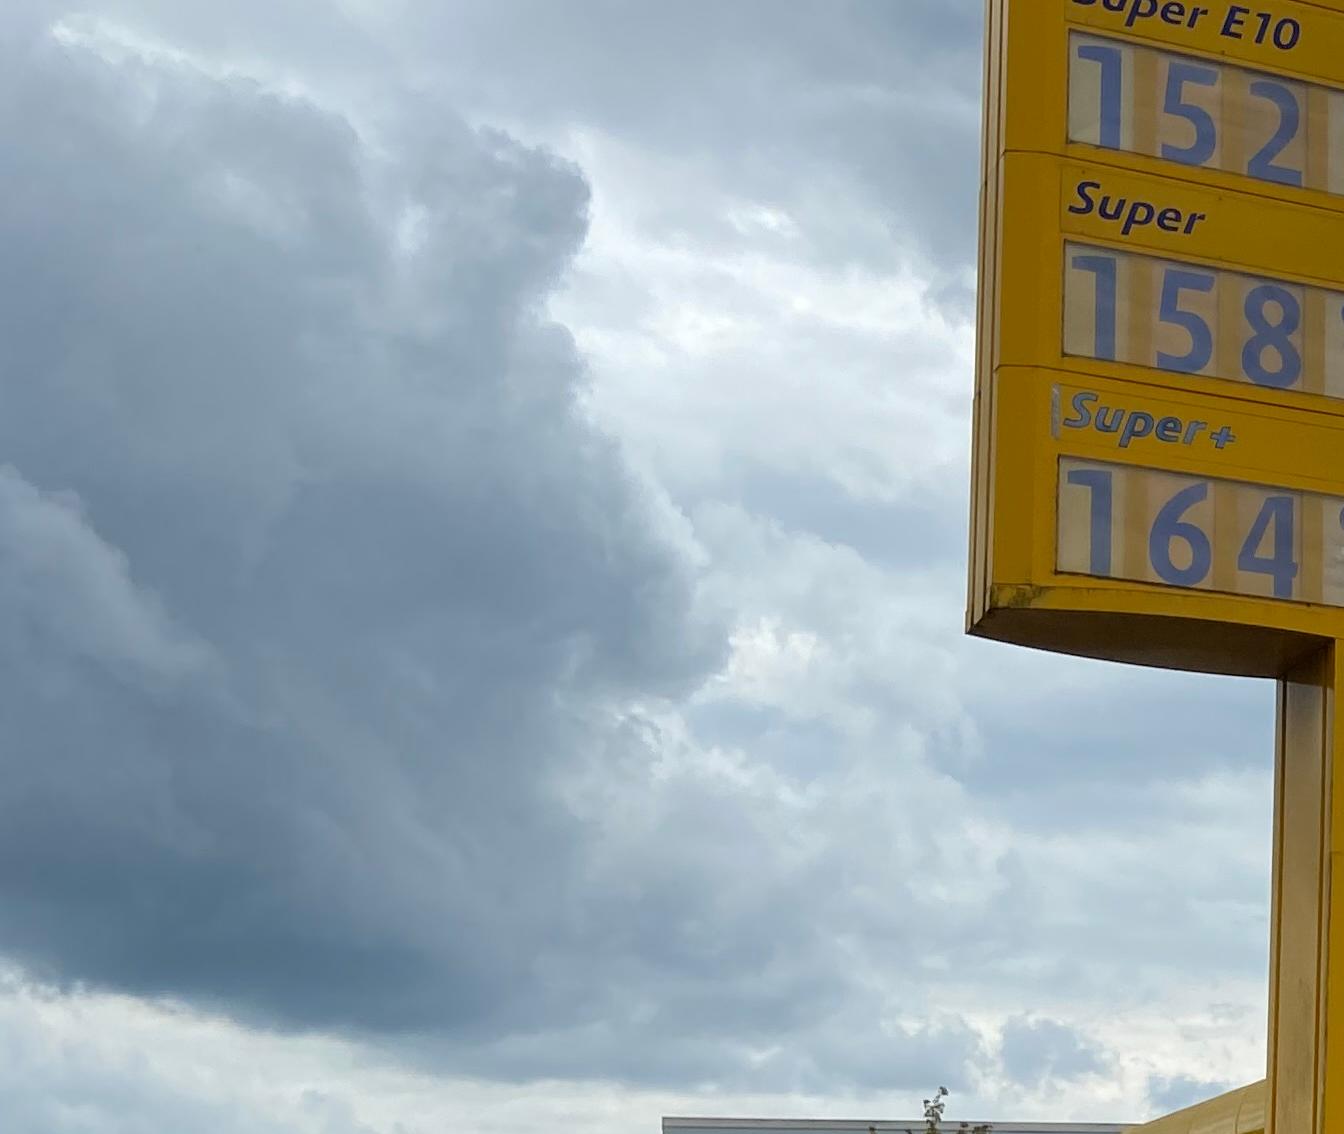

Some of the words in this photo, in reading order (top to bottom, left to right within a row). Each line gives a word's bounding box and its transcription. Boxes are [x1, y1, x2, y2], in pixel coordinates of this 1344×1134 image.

[1071, 0, 1208, 28] per
[1220, 5, 1301, 51] E10
[1068, 180, 1206, 235] Super
[1062, 391, 1237, 450] Super+
